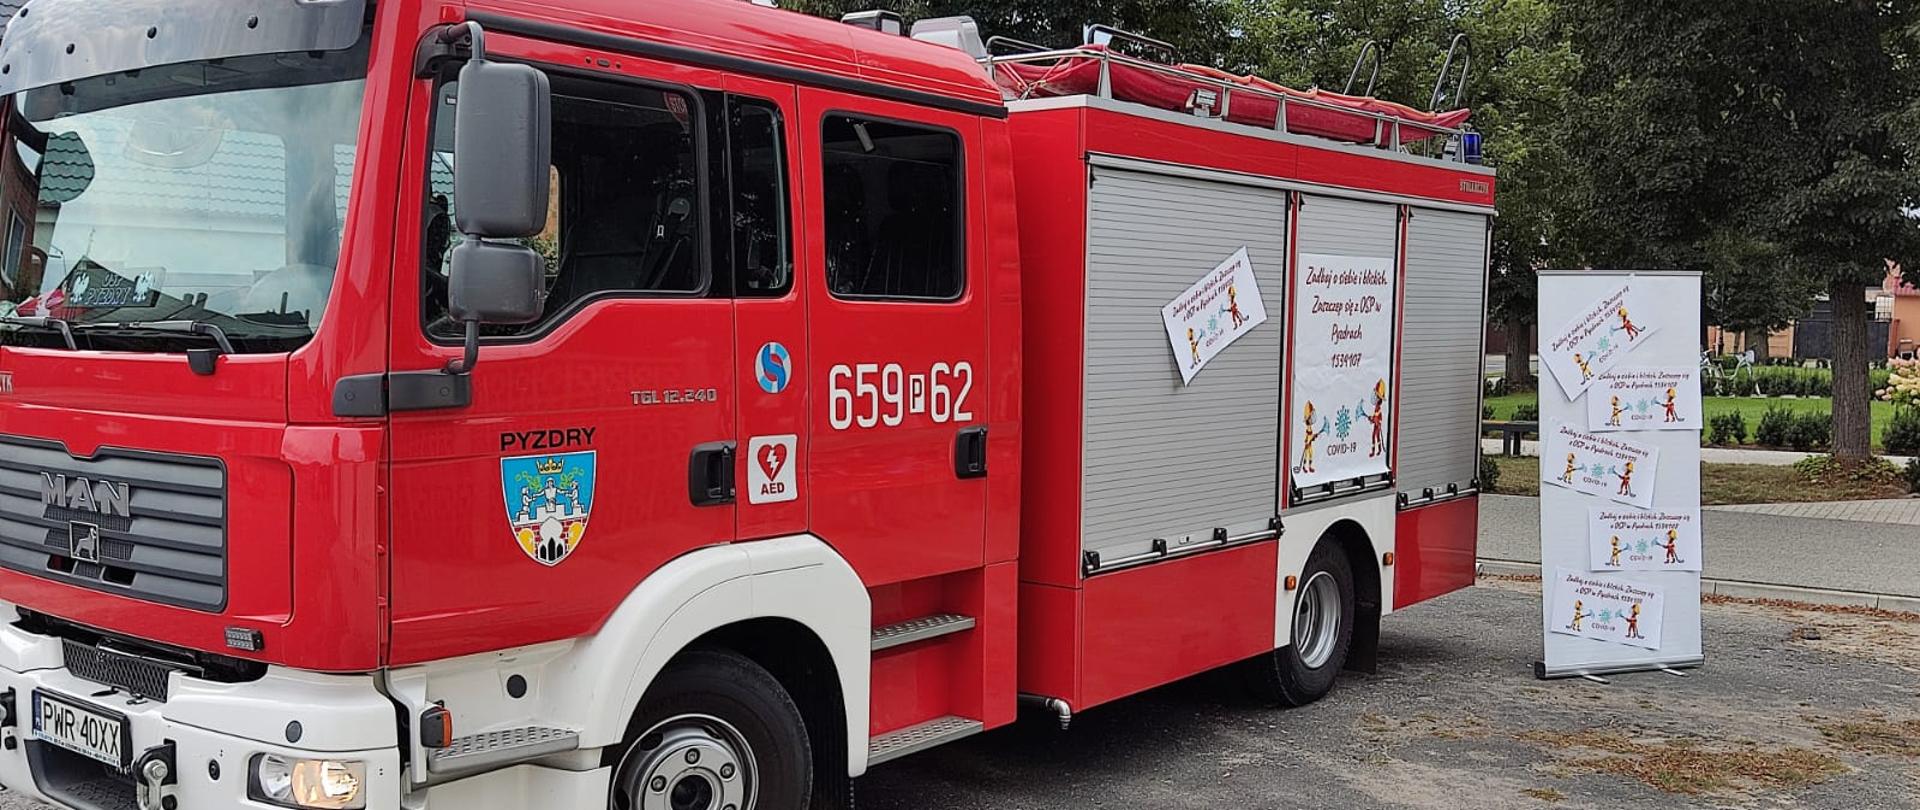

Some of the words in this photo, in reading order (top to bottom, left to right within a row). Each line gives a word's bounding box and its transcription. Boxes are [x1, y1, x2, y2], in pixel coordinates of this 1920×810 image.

[1306, 266, 1332, 288] Zadbaj
[1334, 274, 1338, 284] o
[1340, 269, 1358, 285] siebie
[1358, 272, 1362, 284] i
[1312, 295, 1342, 316] Zaszczep
[1345, 298, 1354, 316] się
[1354, 303, 1359, 312] z
[1360, 296, 1375, 313] OSP
[1376, 302, 1381, 312] w
[630, 390, 661, 405] TGL
[663, 388, 717, 403] 12.240
[500, 426, 596, 451] PYZDRY
[1327, 442, 1356, 456] COVID-19
[41, 471, 130, 517] MAN
[761, 482, 785, 495] AED
[43, 701, 75, 742] PWR
[80, 715, 119, 757] 40XX
